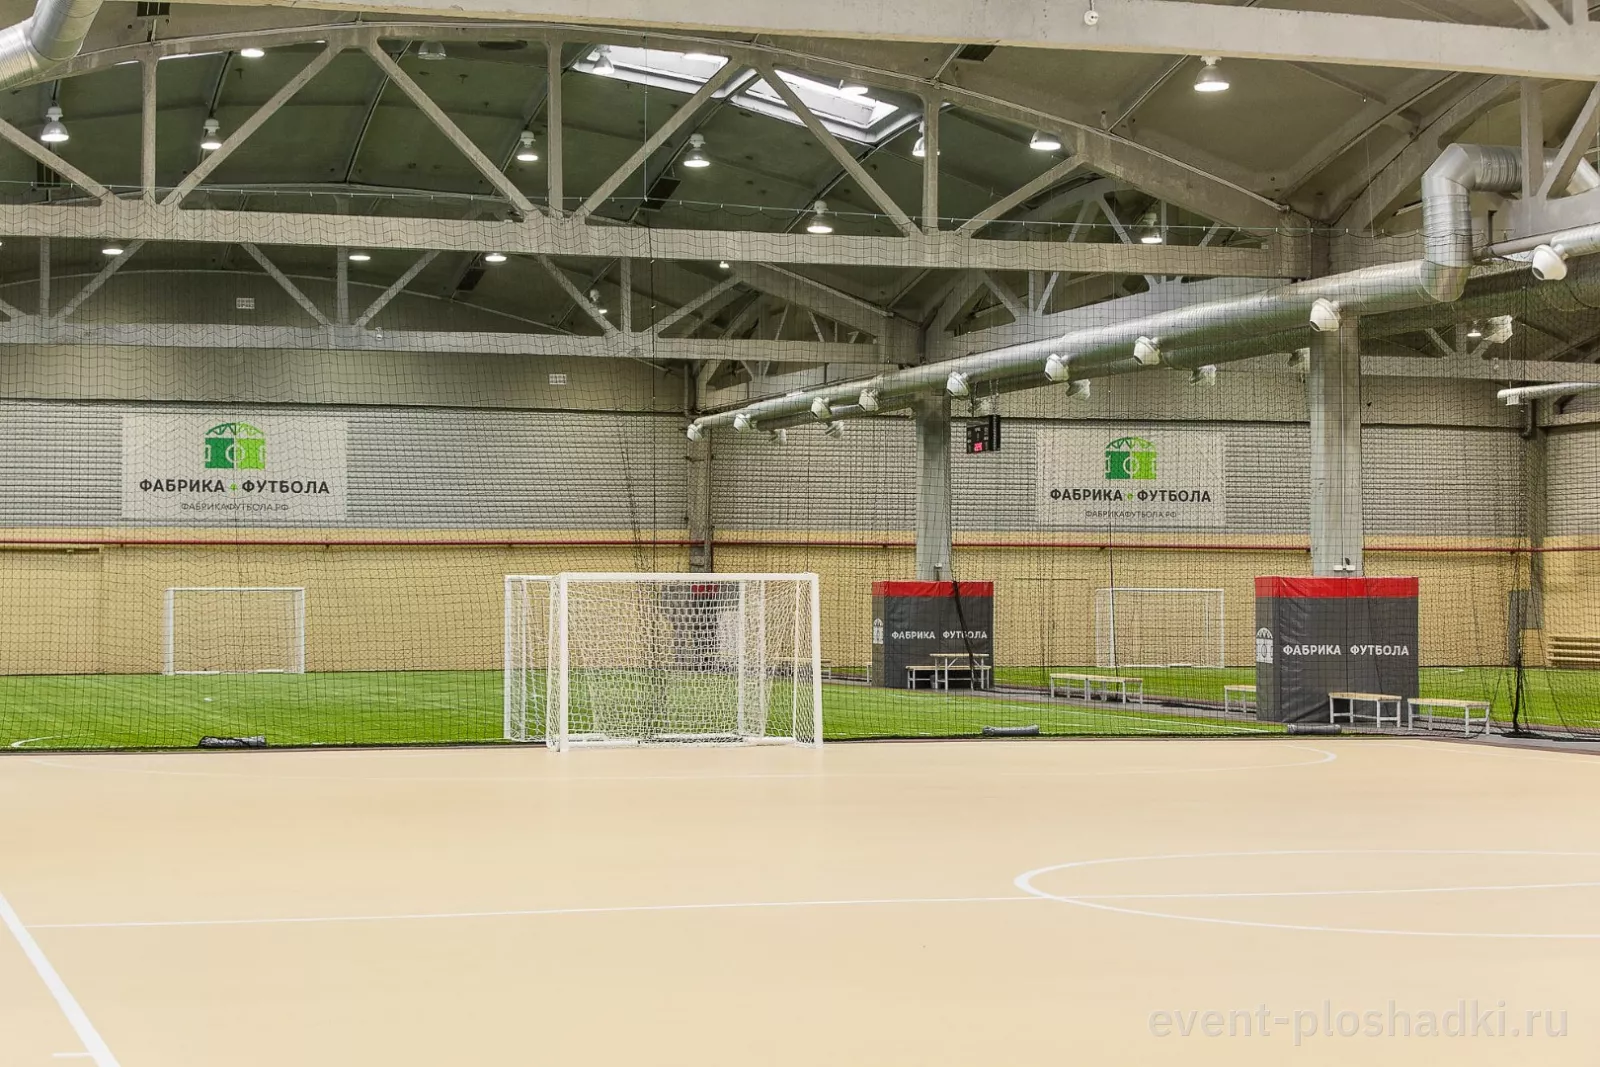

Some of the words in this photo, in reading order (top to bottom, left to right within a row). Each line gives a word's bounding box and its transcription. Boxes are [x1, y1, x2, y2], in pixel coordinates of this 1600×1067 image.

[139, 479, 225, 493] ФАБРИКА
[241, 480, 330, 494] ФУТБОЛА
[1050, 489, 1123, 501] ФАБРИКА
[1137, 490, 1211, 502] ФУТБОЛА
[181, 503, 289, 511] ФАБРИКАФУТБОЛА.РФ
[891, 631, 936, 639] ФАБРИКА
[1283, 645, 1342, 655] ФАБРИКА
[1350, 645, 1409, 656] ФУТБОЛА
